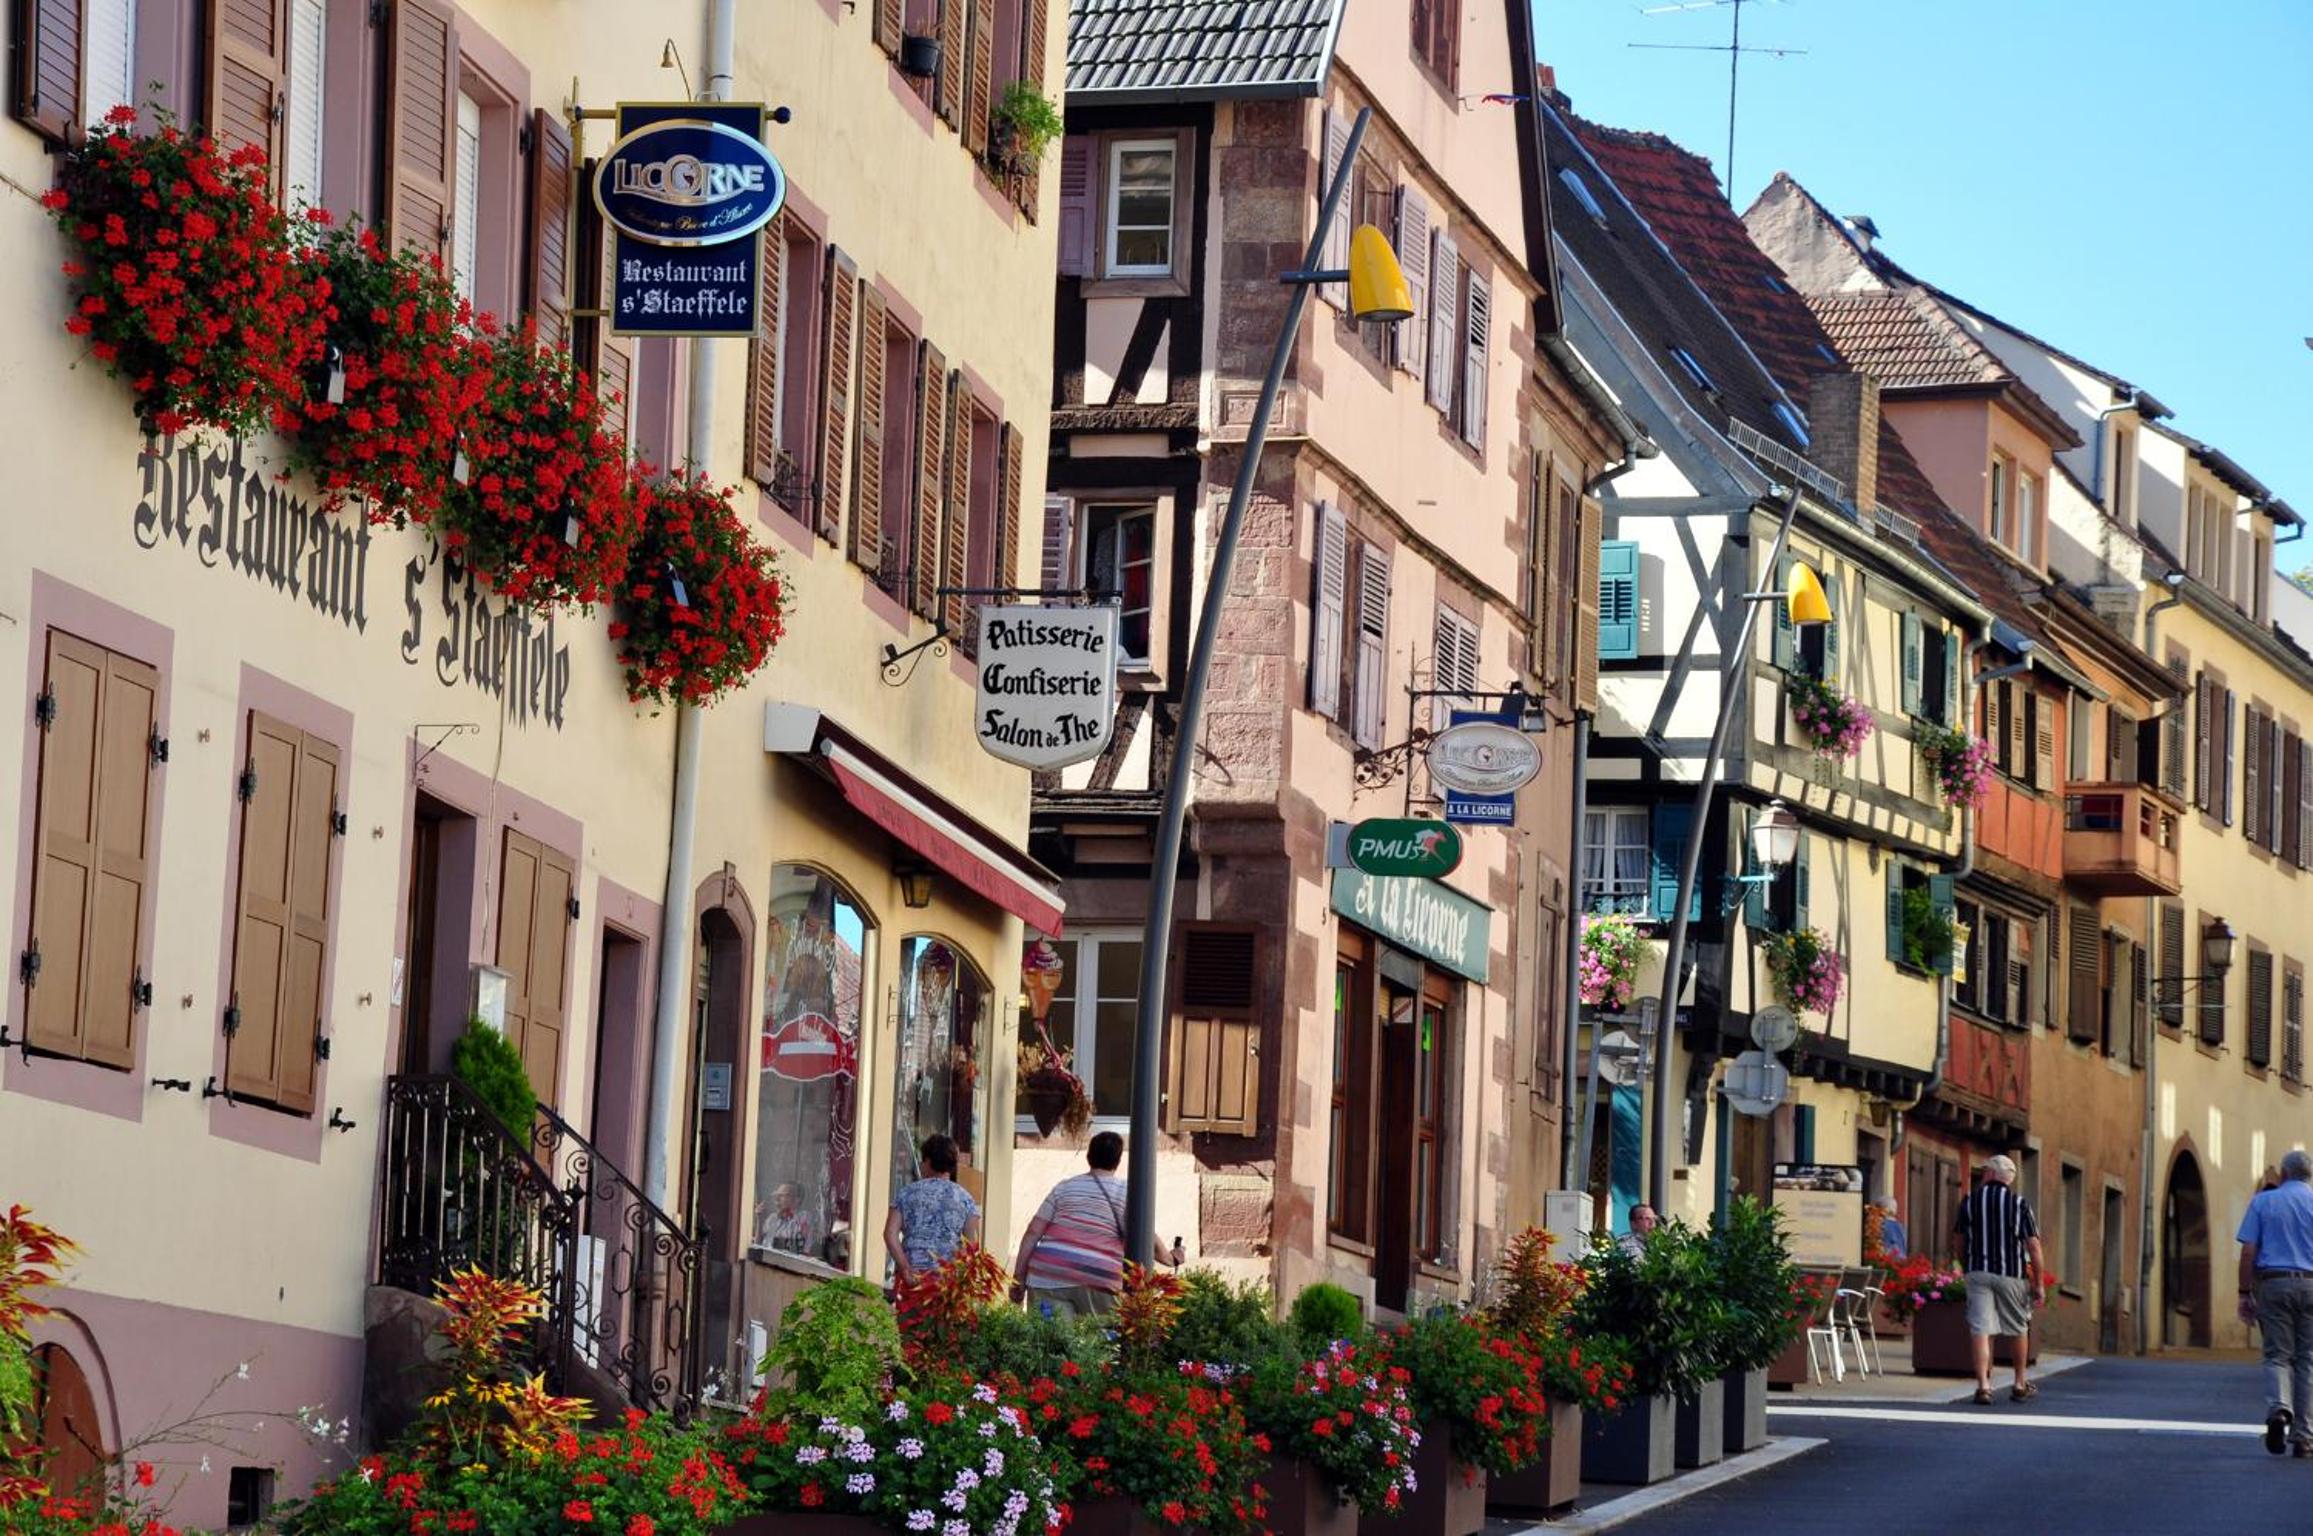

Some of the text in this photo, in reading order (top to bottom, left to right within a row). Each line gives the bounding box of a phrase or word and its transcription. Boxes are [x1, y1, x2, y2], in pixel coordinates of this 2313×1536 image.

[613, 154, 765, 198] LICORNE
[622, 258, 746, 283] Restaurant
[622, 288, 747, 319] s'Staeffele
[134, 425, 372, 636] Restaurant
[987, 620, 1104, 653] Patisserie
[983, 663, 1102, 694] Confiserie
[980, 709, 1098, 748] Salon de The
[1457, 805, 1468, 815] LA
[1472, 806, 1512, 816] LICORNE
[1358, 839, 1413, 859] PMU
[1402, 876, 1470, 966] Licorne
